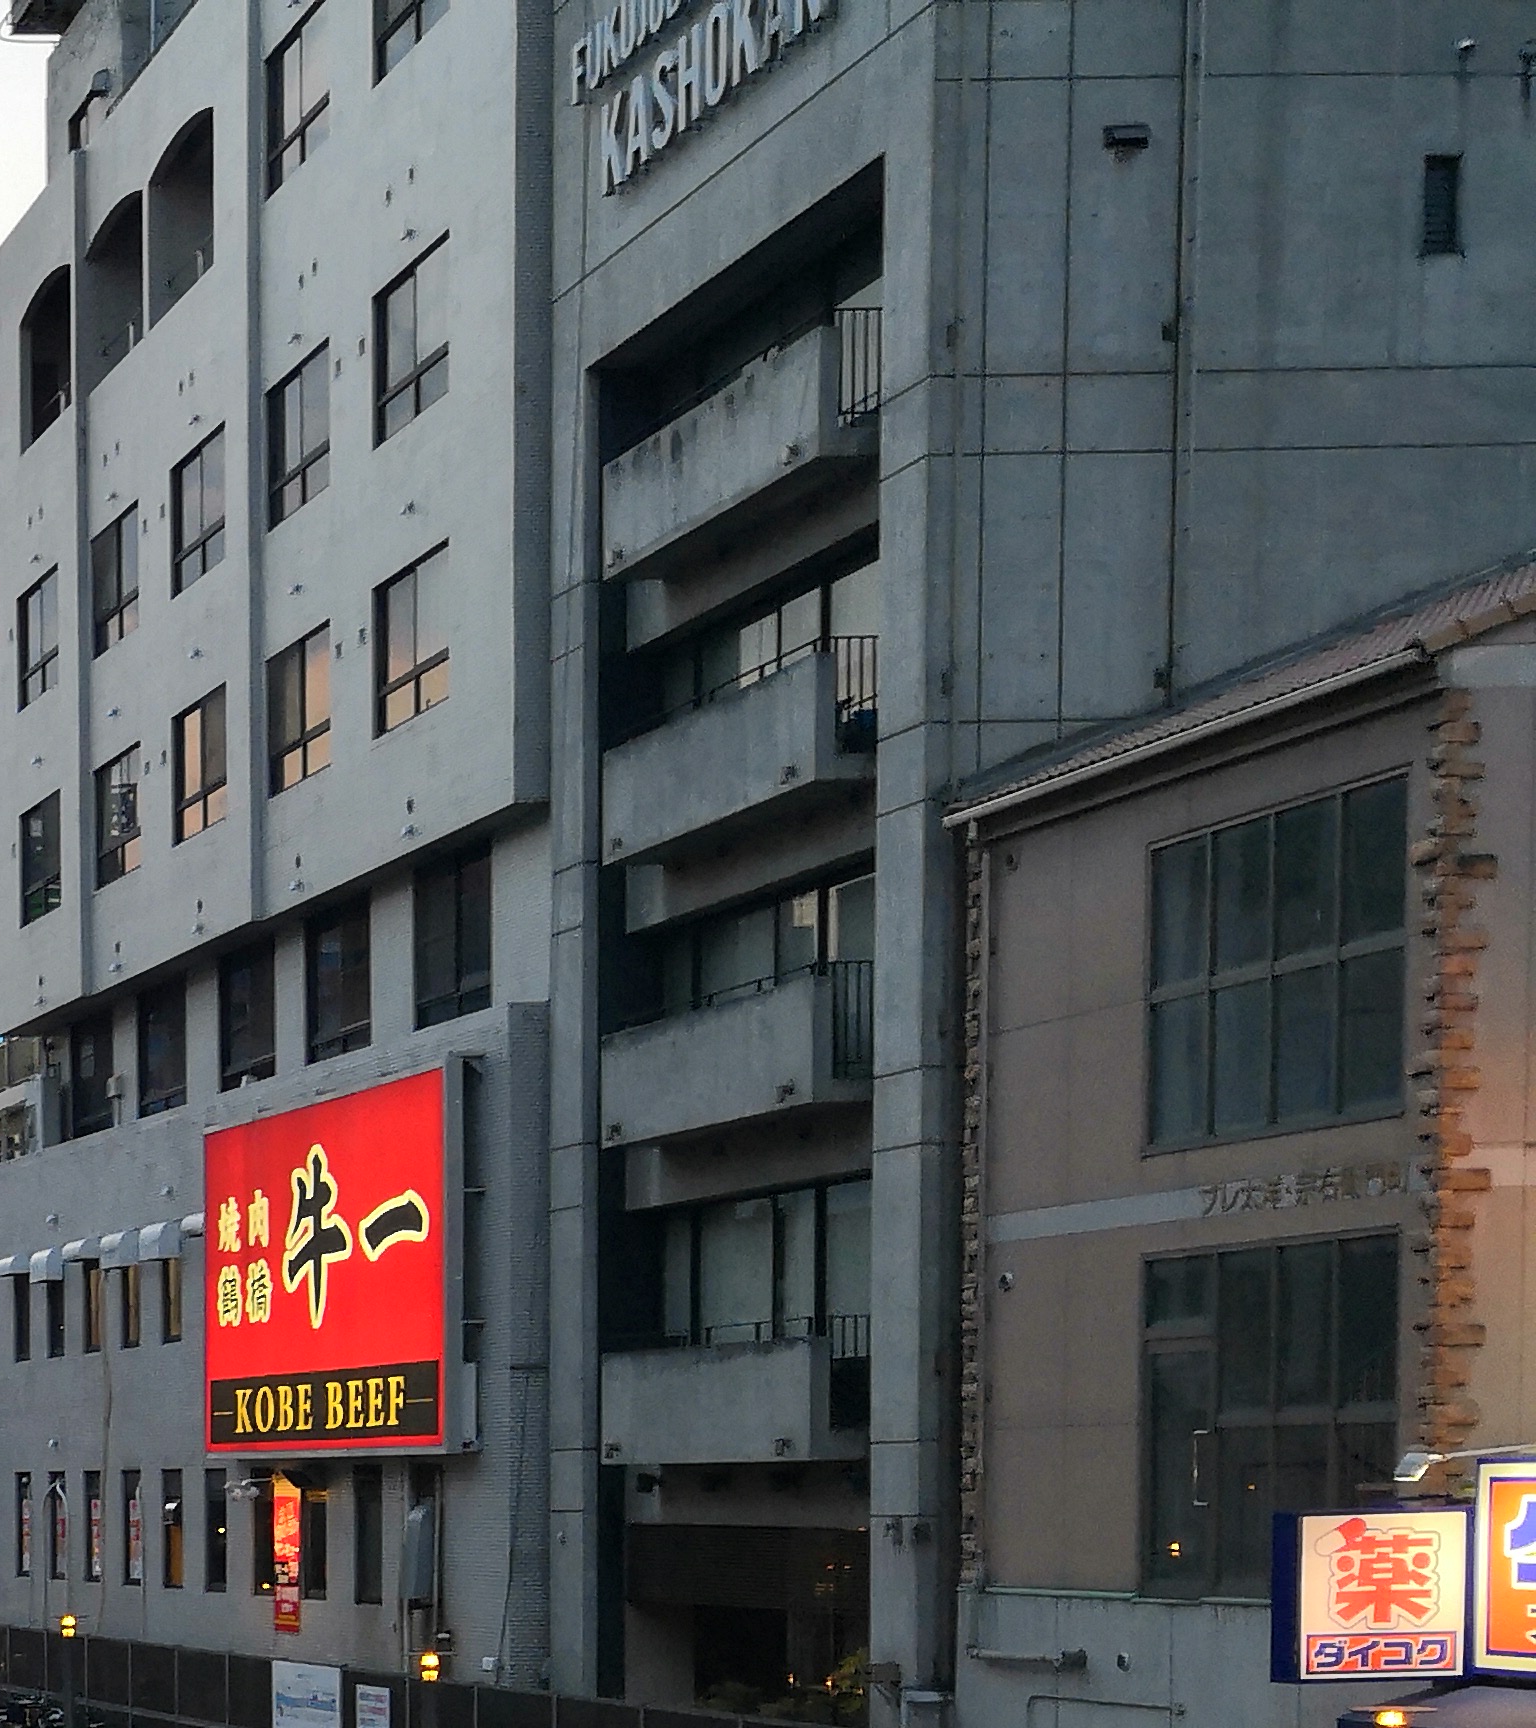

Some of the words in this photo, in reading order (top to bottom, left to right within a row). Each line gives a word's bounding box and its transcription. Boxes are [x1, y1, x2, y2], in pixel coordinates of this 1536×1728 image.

[282, 1144, 430, 1329] 牛一
[234, 1383, 314, 1434] KOBE
[325, 1375, 406, 1430] BEEF
[1333, 1532, 1434, 1625] 薬
[1313, 1639, 1450, 1669] ダイコク
